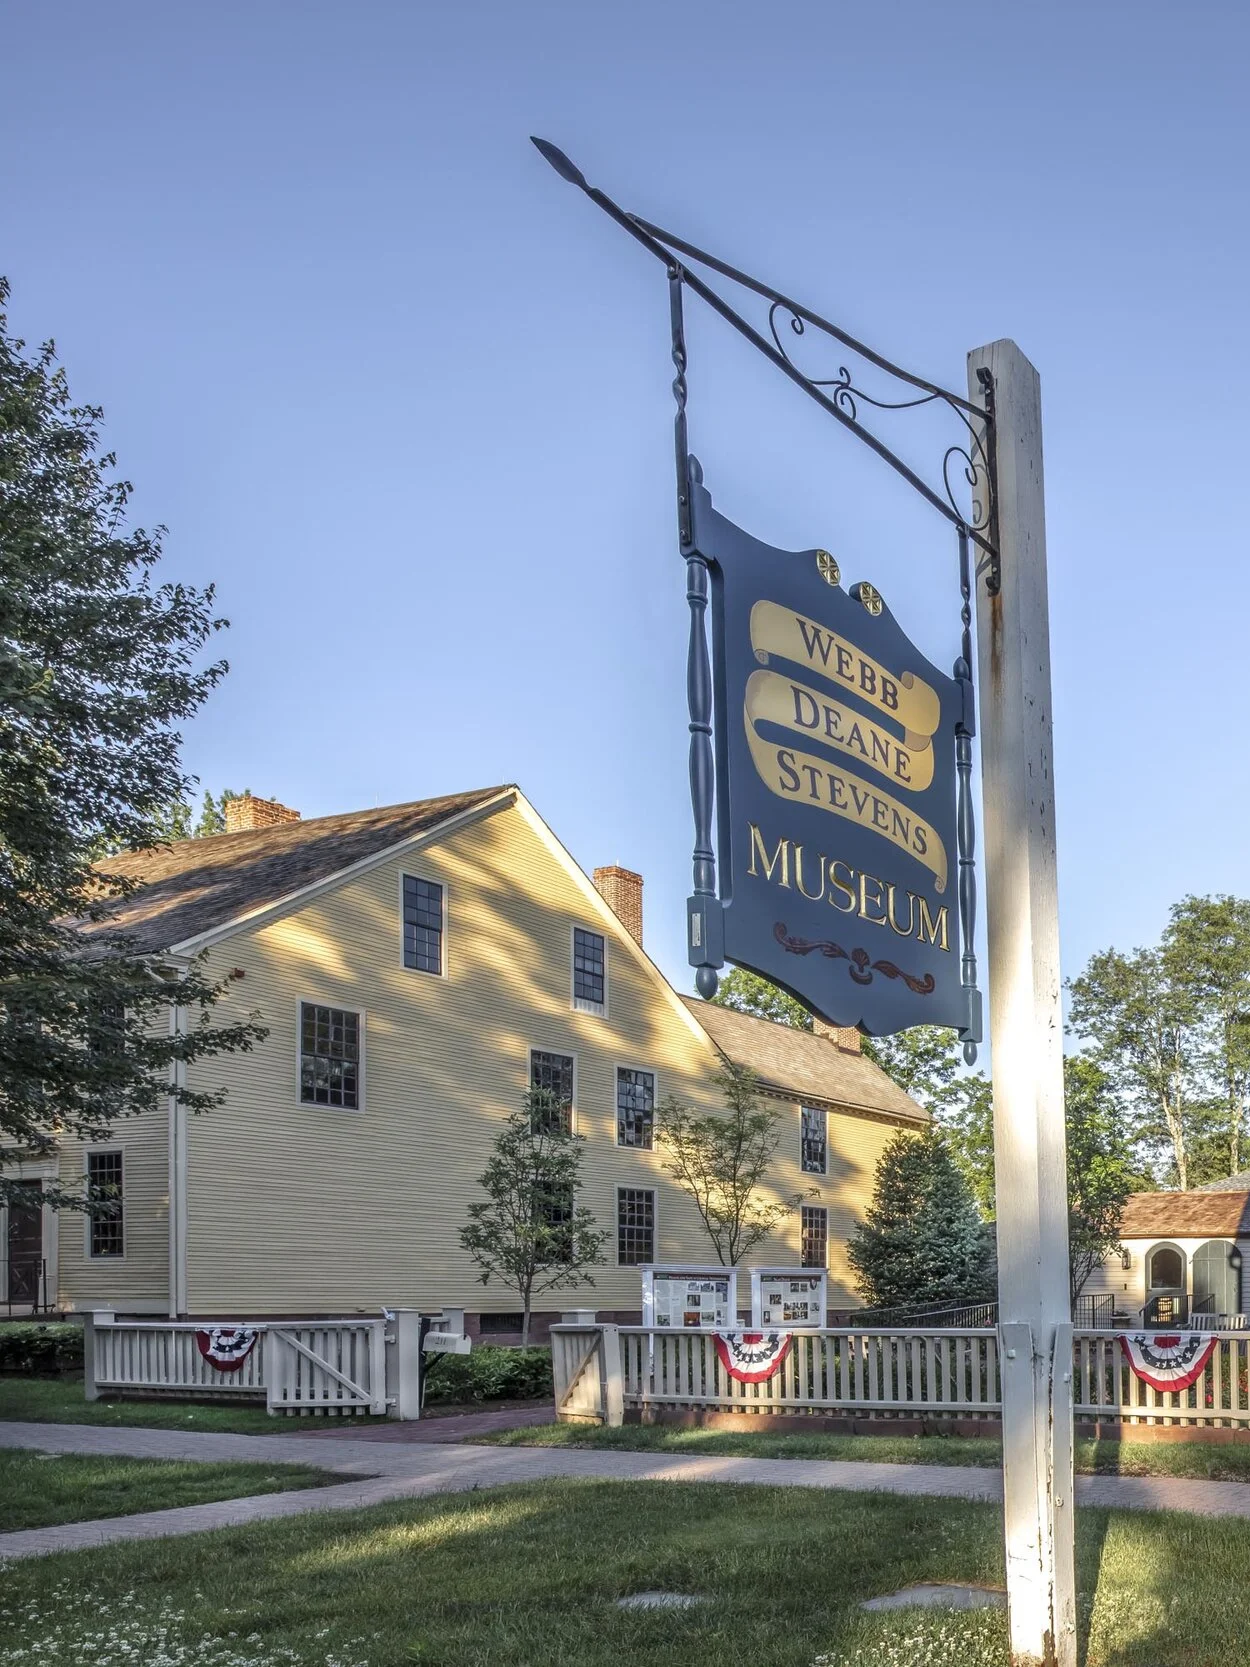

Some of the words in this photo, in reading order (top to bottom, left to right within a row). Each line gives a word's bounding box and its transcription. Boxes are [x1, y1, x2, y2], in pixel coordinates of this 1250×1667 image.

[796, 617, 898, 711] WEBB
[791, 684, 911, 783] DEANE
[778, 749, 928, 856] STEVENS
[746, 821, 950, 952] MUSEUM
